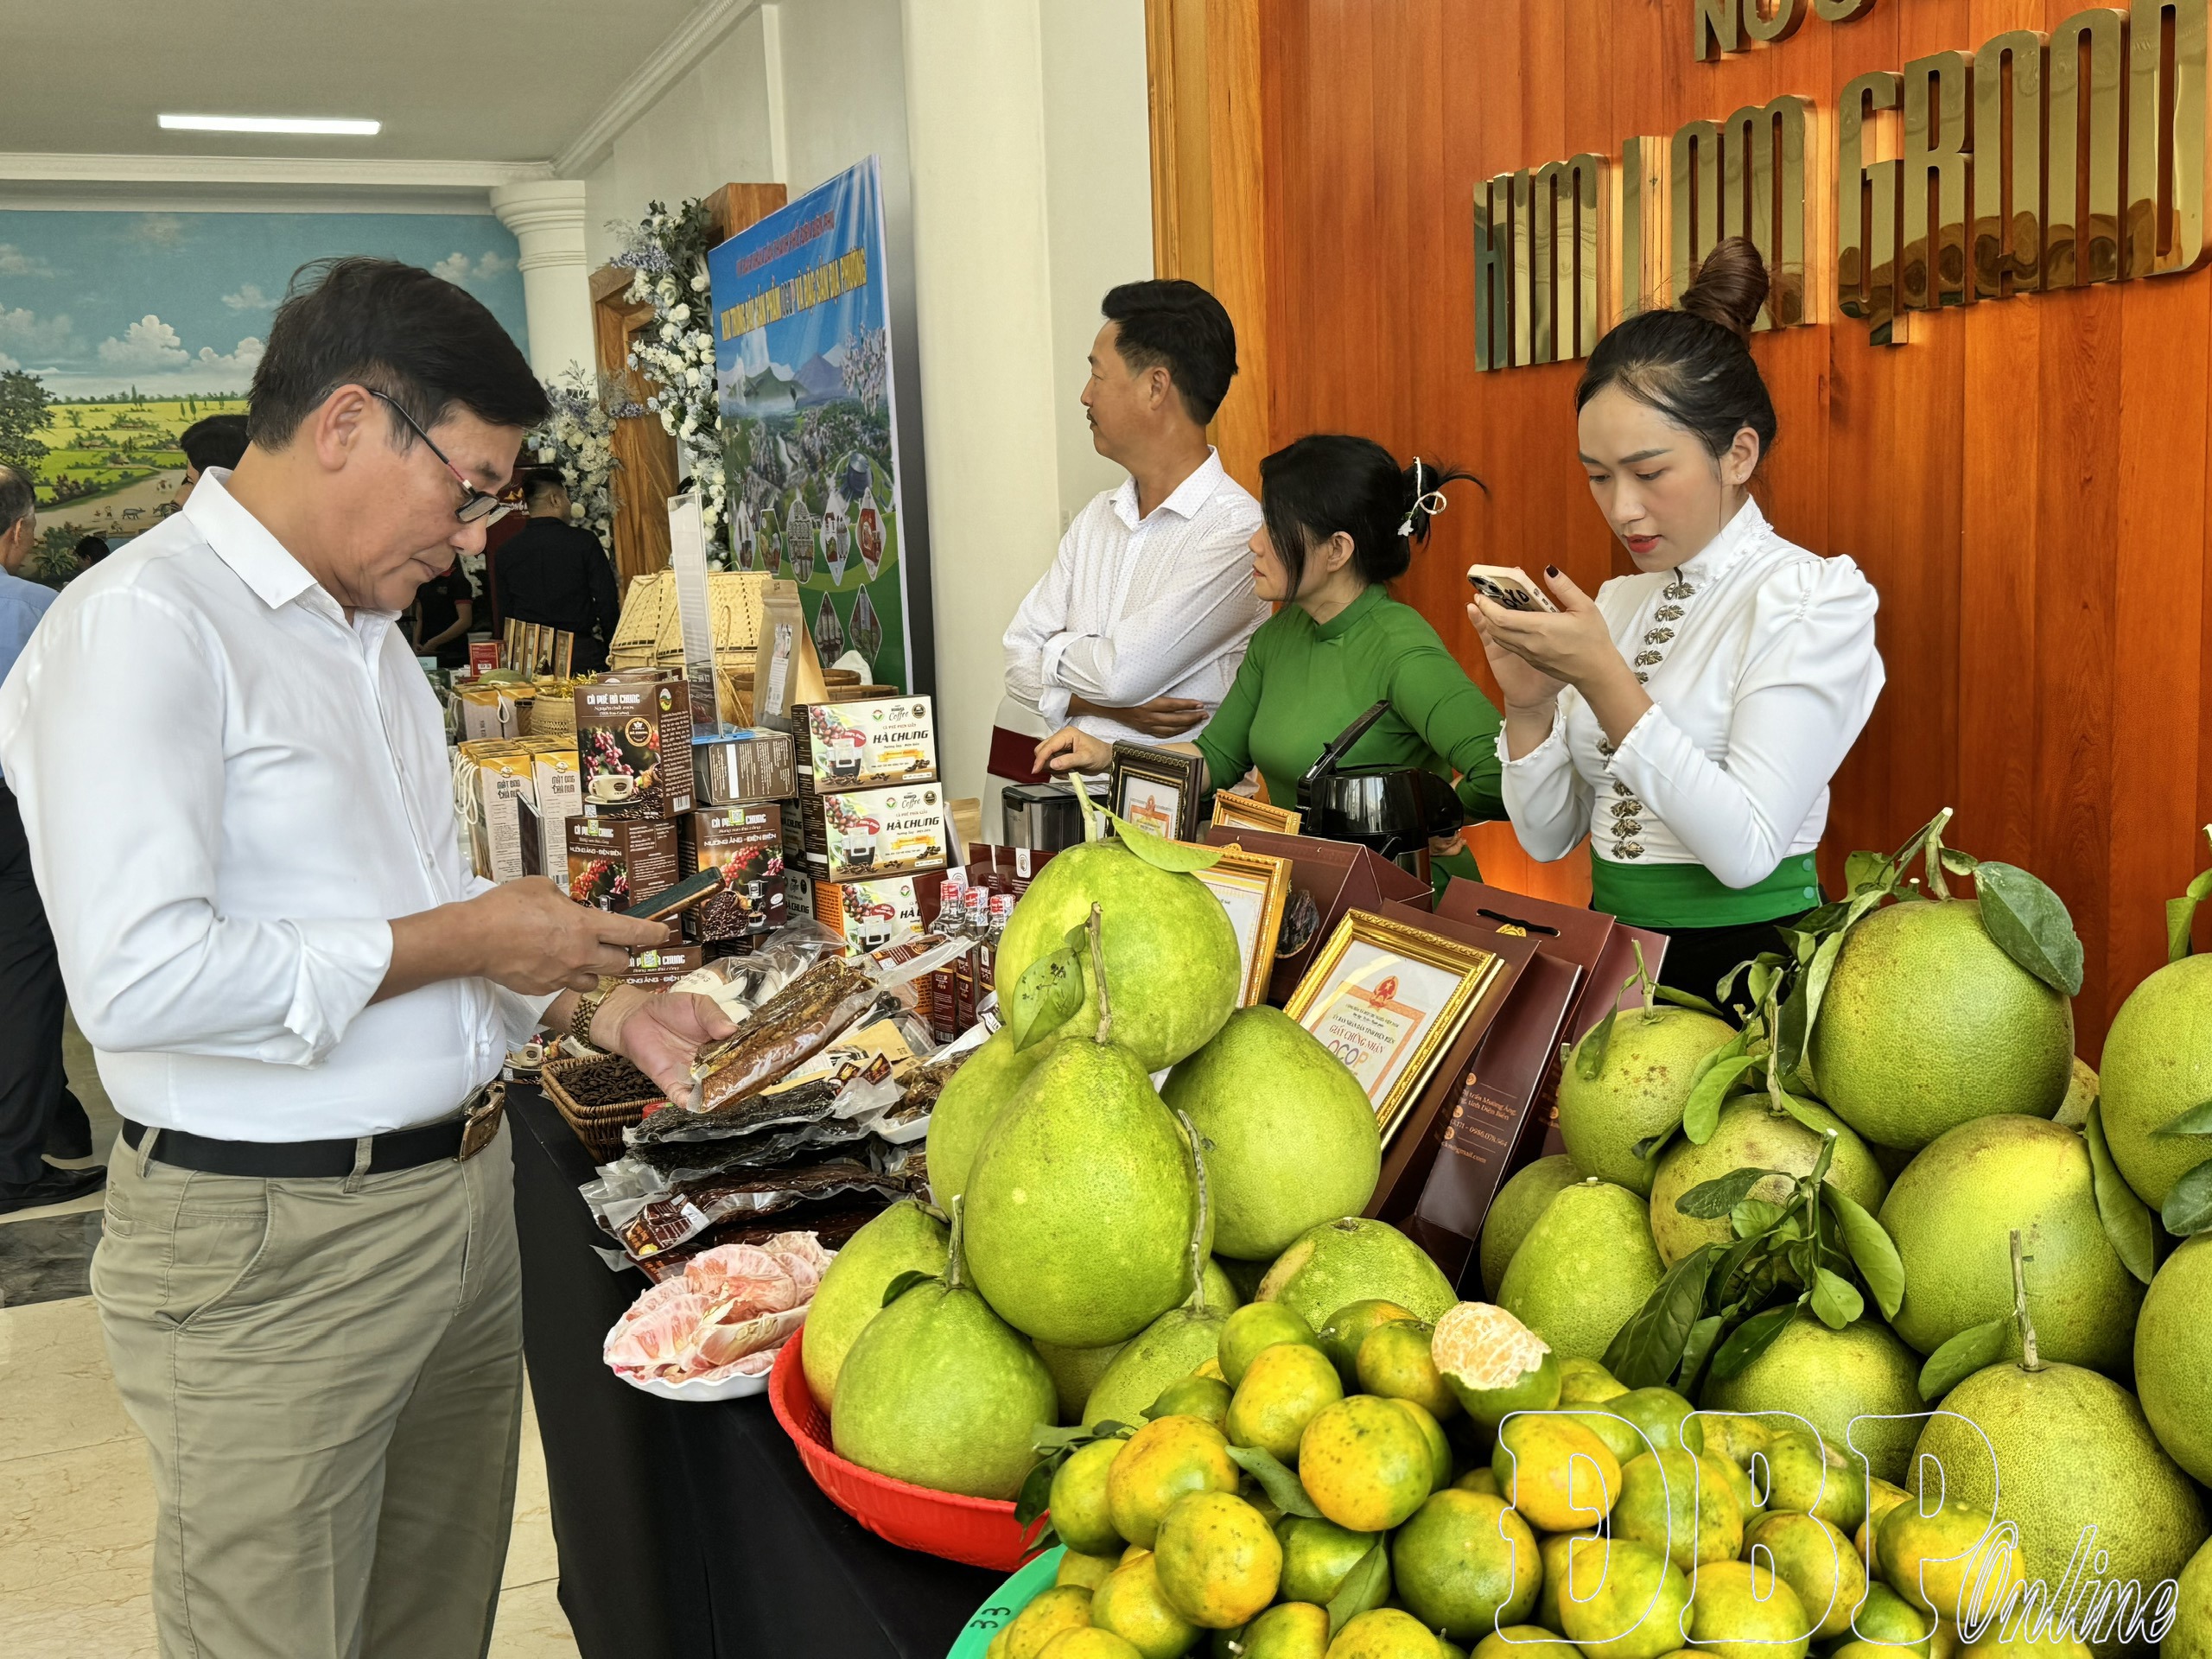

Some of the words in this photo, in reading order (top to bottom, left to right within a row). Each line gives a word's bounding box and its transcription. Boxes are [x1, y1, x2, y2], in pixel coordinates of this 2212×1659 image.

[873, 732, 888, 744] HÀ
[891, 730, 929, 742] CHUNG
[887, 819, 901, 831] HÀ
[904, 817, 940, 830] CHUNG
[899, 908, 916, 919] HÀ
[1327, 1039, 1370, 1068] OCOP
